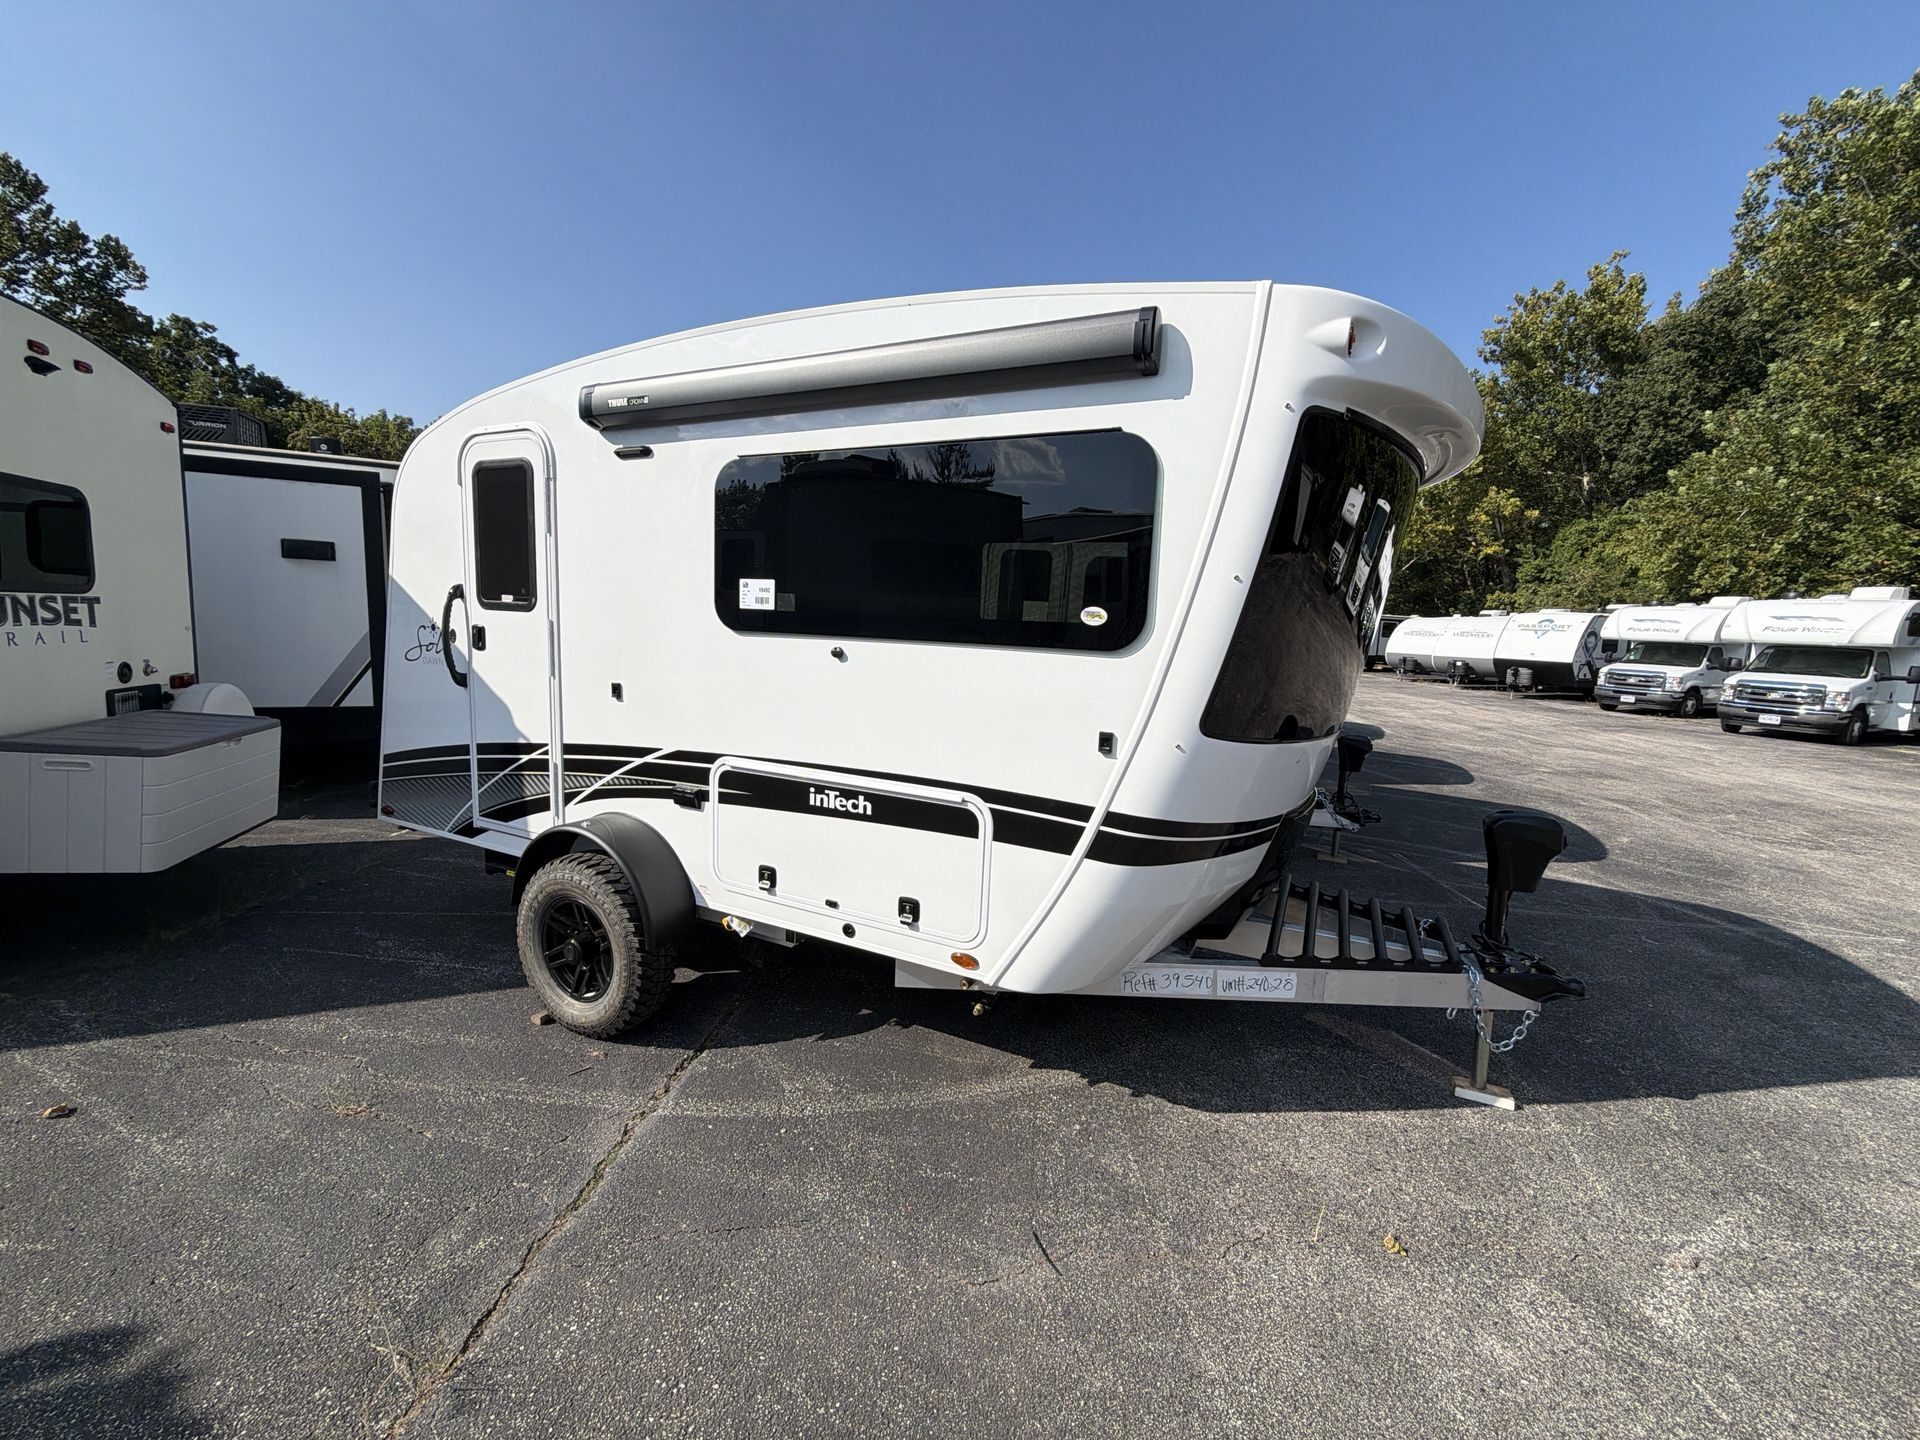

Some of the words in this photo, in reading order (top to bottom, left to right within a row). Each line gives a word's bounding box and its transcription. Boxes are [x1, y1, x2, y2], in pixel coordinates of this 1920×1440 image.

[608, 397, 628, 408] THULE
[1762, 625, 1799, 633] FOUR
[809, 786, 872, 816] inTech
[1160, 972, 1214, 990] 39540
